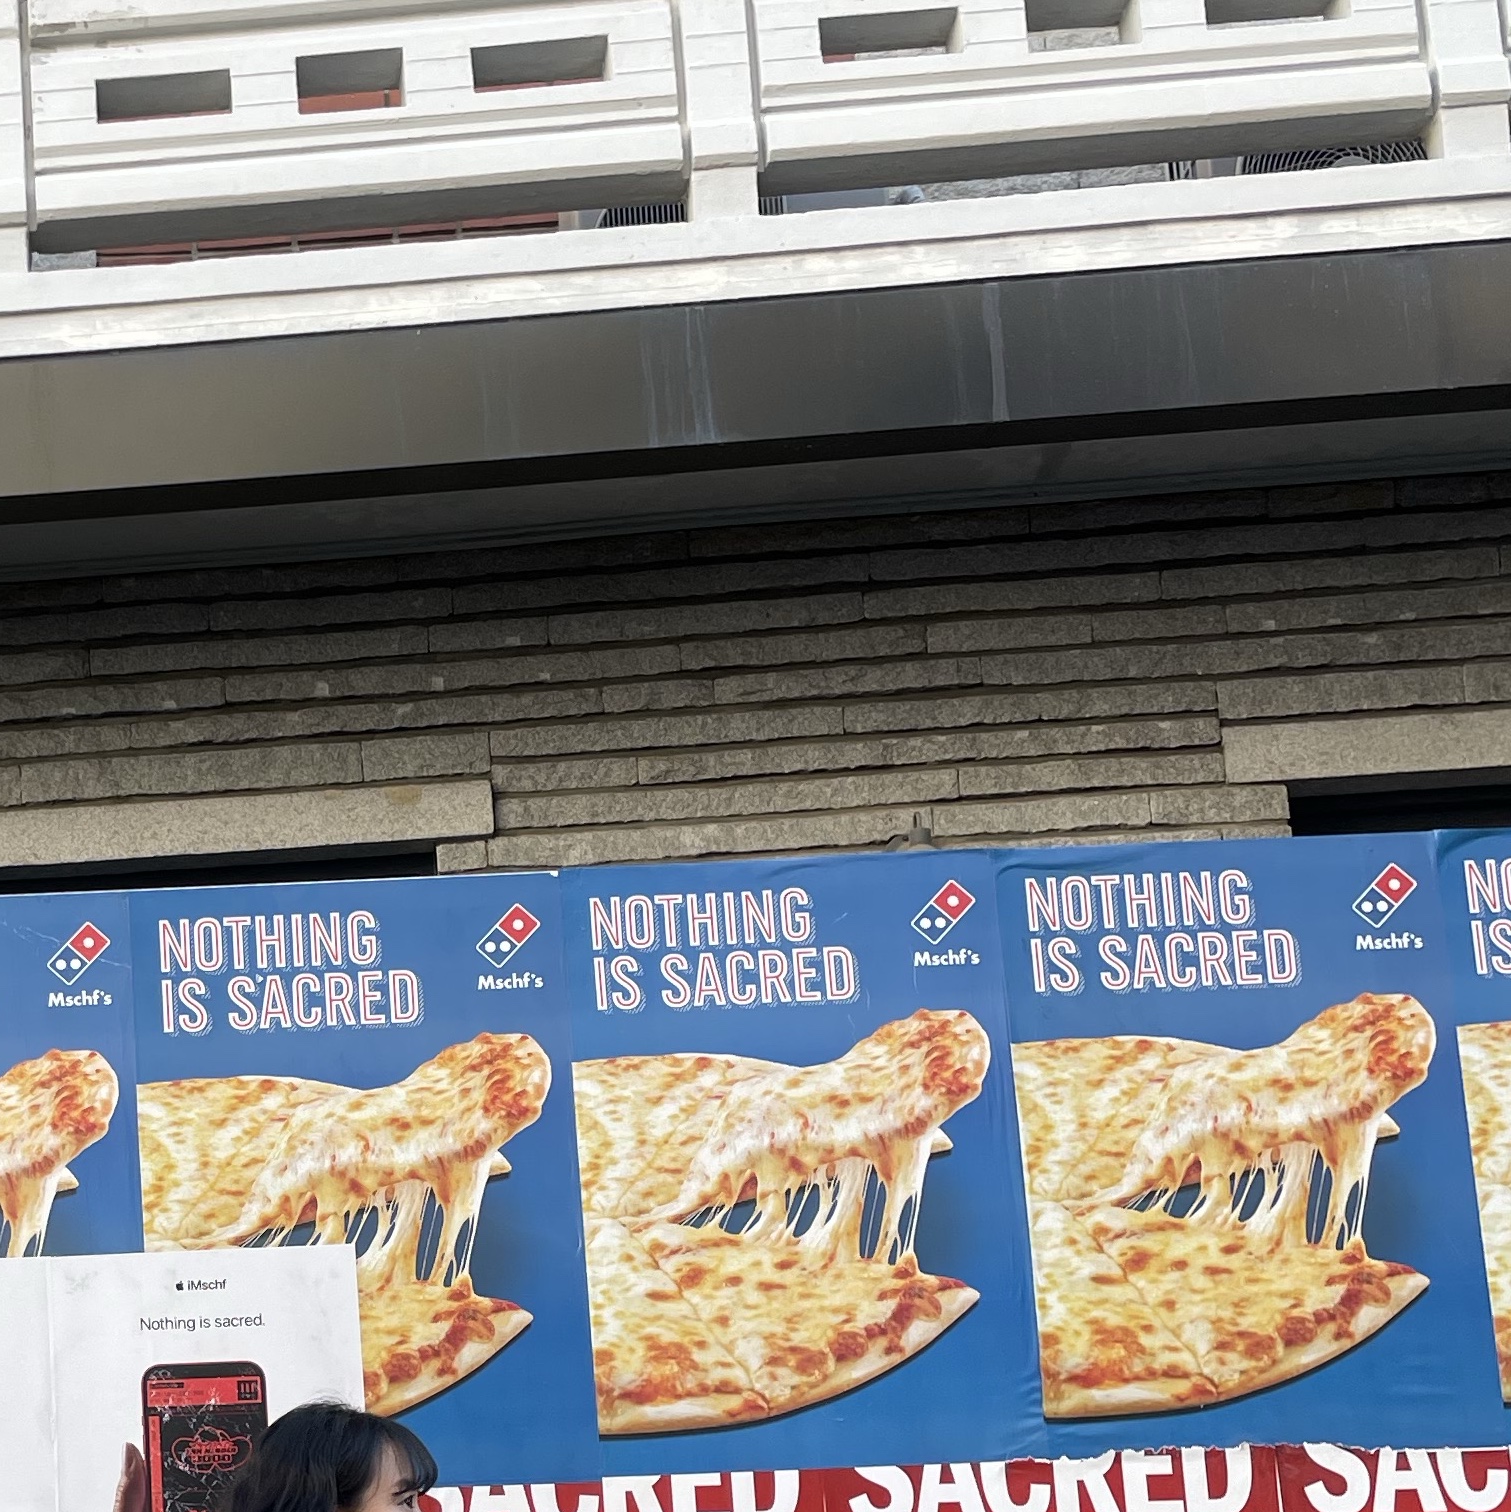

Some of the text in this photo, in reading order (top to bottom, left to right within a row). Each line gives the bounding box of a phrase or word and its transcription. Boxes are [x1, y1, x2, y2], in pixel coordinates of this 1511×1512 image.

[589, 888, 815, 953] NOTHING
[1024, 869, 1254, 935] NOTHING
[159, 911, 381, 974] NOTHING
[913, 949, 981, 967] Mschf's
[1030, 929, 1302, 997] IS SACRED
[1356, 934, 1424, 951] Mschf's
[47, 991, 112, 1008] Mschf's
[477, 973, 544, 991] Mschf's
[593, 946, 861, 1013] IS SACRED
[161, 970, 424, 1037] IS SACRED
[187, 1278, 227, 1292] iMschf
[140, 1313, 265, 1332] Nothing is sacred.
